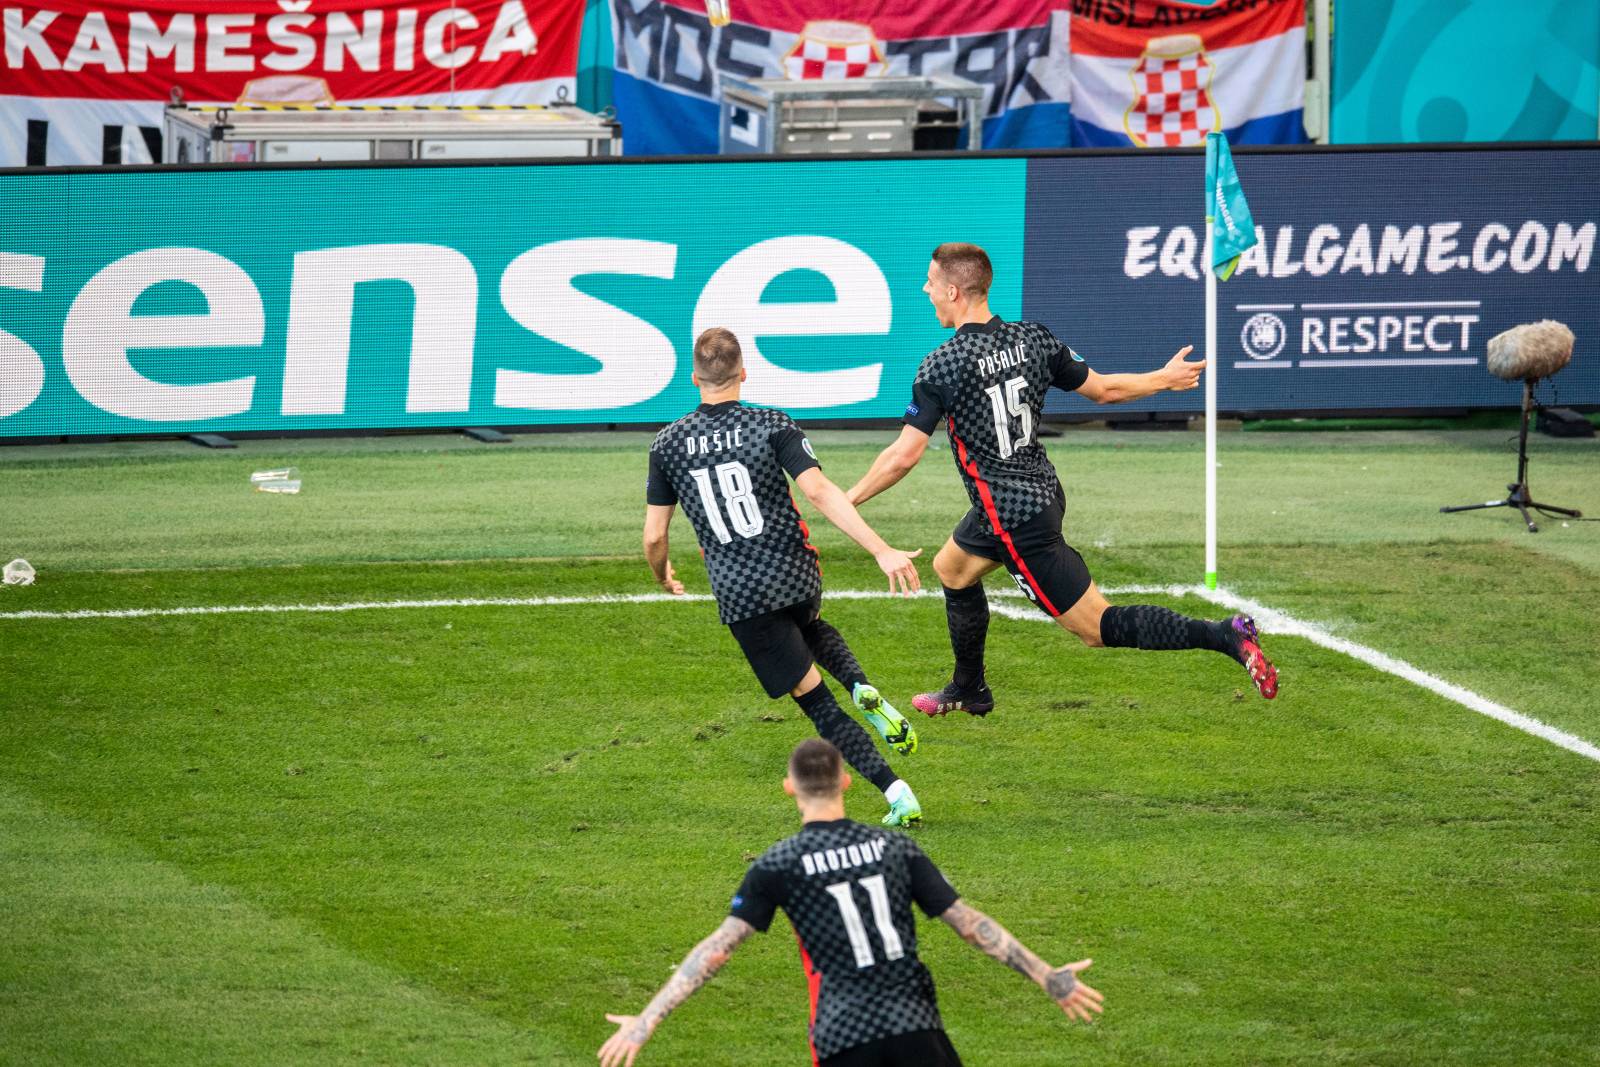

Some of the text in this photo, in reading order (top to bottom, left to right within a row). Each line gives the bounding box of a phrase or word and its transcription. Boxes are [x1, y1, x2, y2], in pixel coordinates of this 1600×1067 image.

[3, 0, 539, 74] KAMEŠNICA
[1123, 220, 1597, 281] EQALGAME.COM
[0, 233, 894, 422] ense
[977, 340, 1029, 377] PAŠALIĆ
[1301, 314, 1481, 354] RESPECT
[686, 425, 743, 455] DRŠIĆ
[984, 375, 1033, 460] 15
[688, 460, 765, 545] 18
[825, 873, 905, 969] 11
